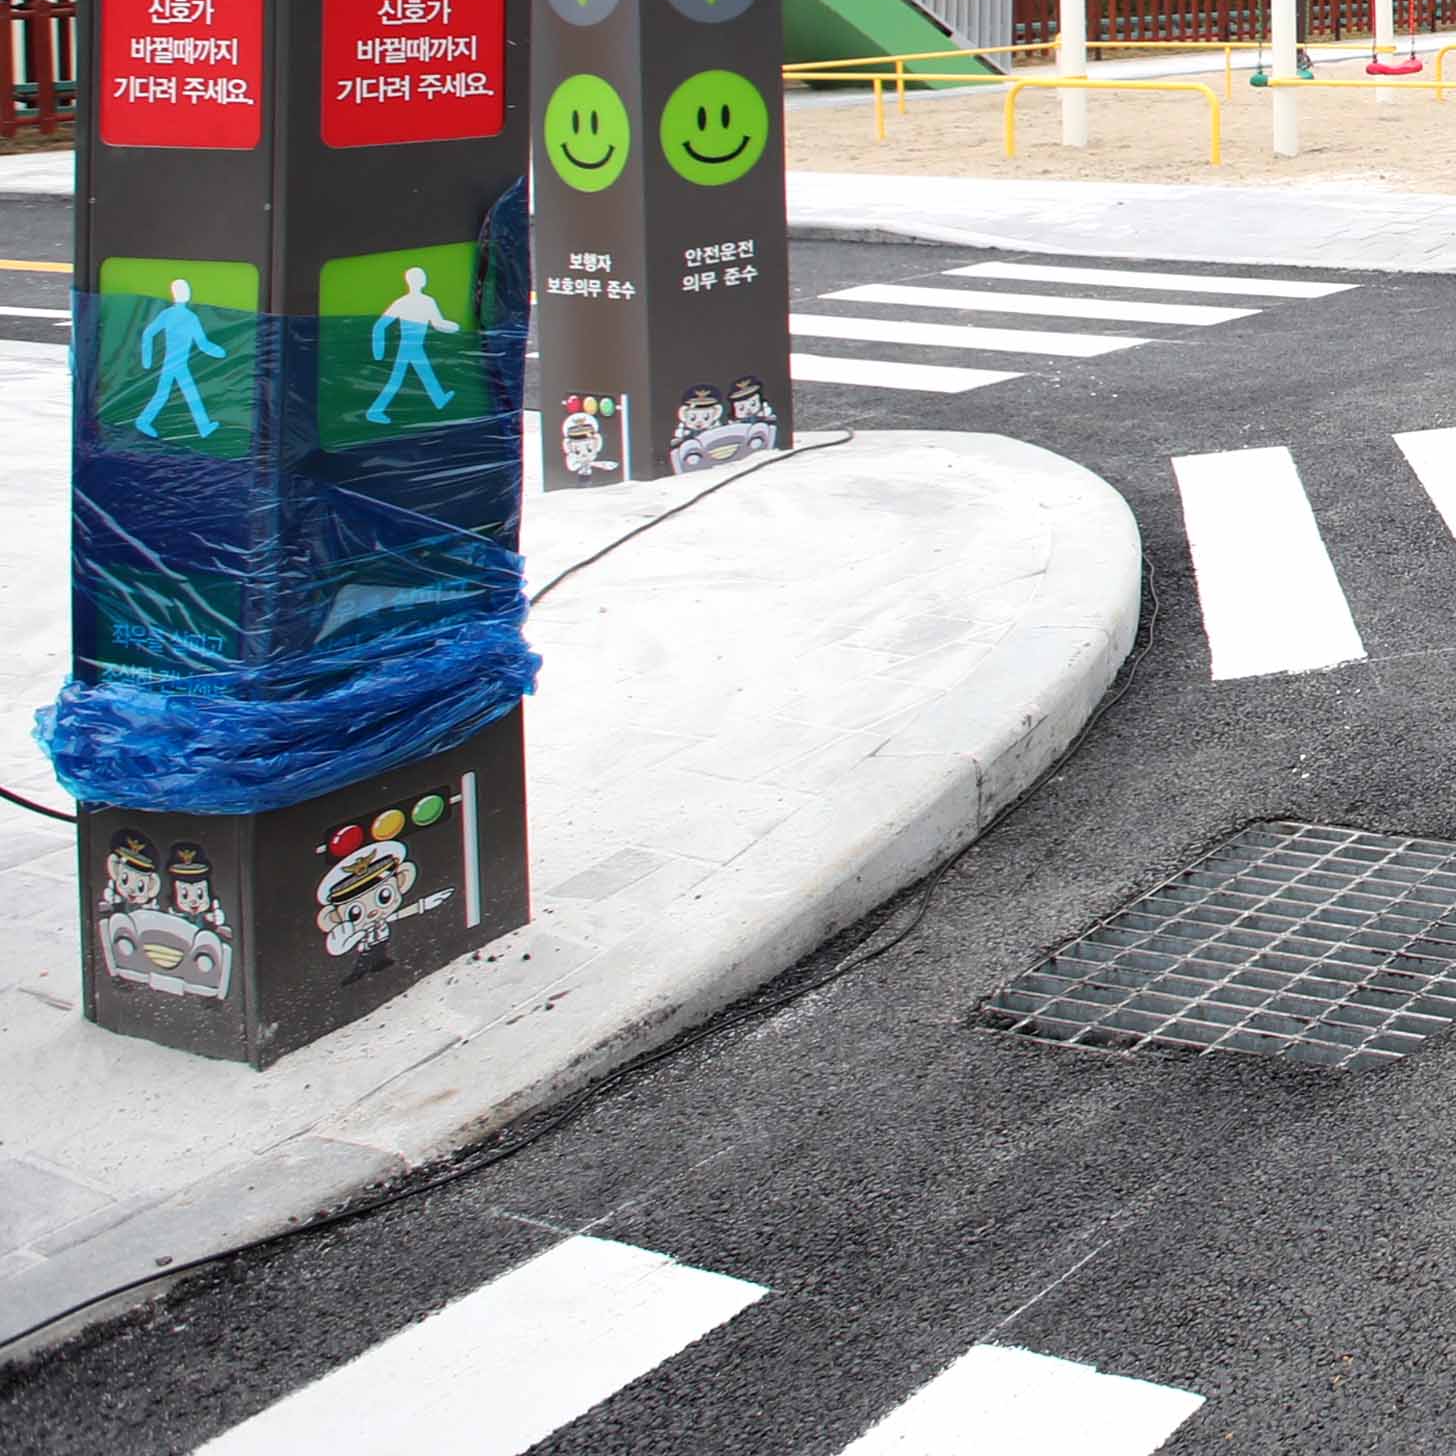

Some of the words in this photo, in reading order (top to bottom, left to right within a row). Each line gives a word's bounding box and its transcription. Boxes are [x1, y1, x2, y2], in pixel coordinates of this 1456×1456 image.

[130, 36, 239, 66] 바뀔때까지
[356, 35, 478, 65] 바뀔때까지
[113, 76, 178, 105] 기다려
[182, 77, 254, 106] 주세요.
[336, 75, 410, 105] 기다려
[416, 71, 495, 100] 주세요.
[569, 252, 612, 273] 보행자
[684, 239, 755, 268] 안전운전
[547, 277, 602, 298] 보호의무
[606, 279, 637, 300] 준수
[681, 271, 719, 293] 의무
[723, 264, 759, 286] 준수
